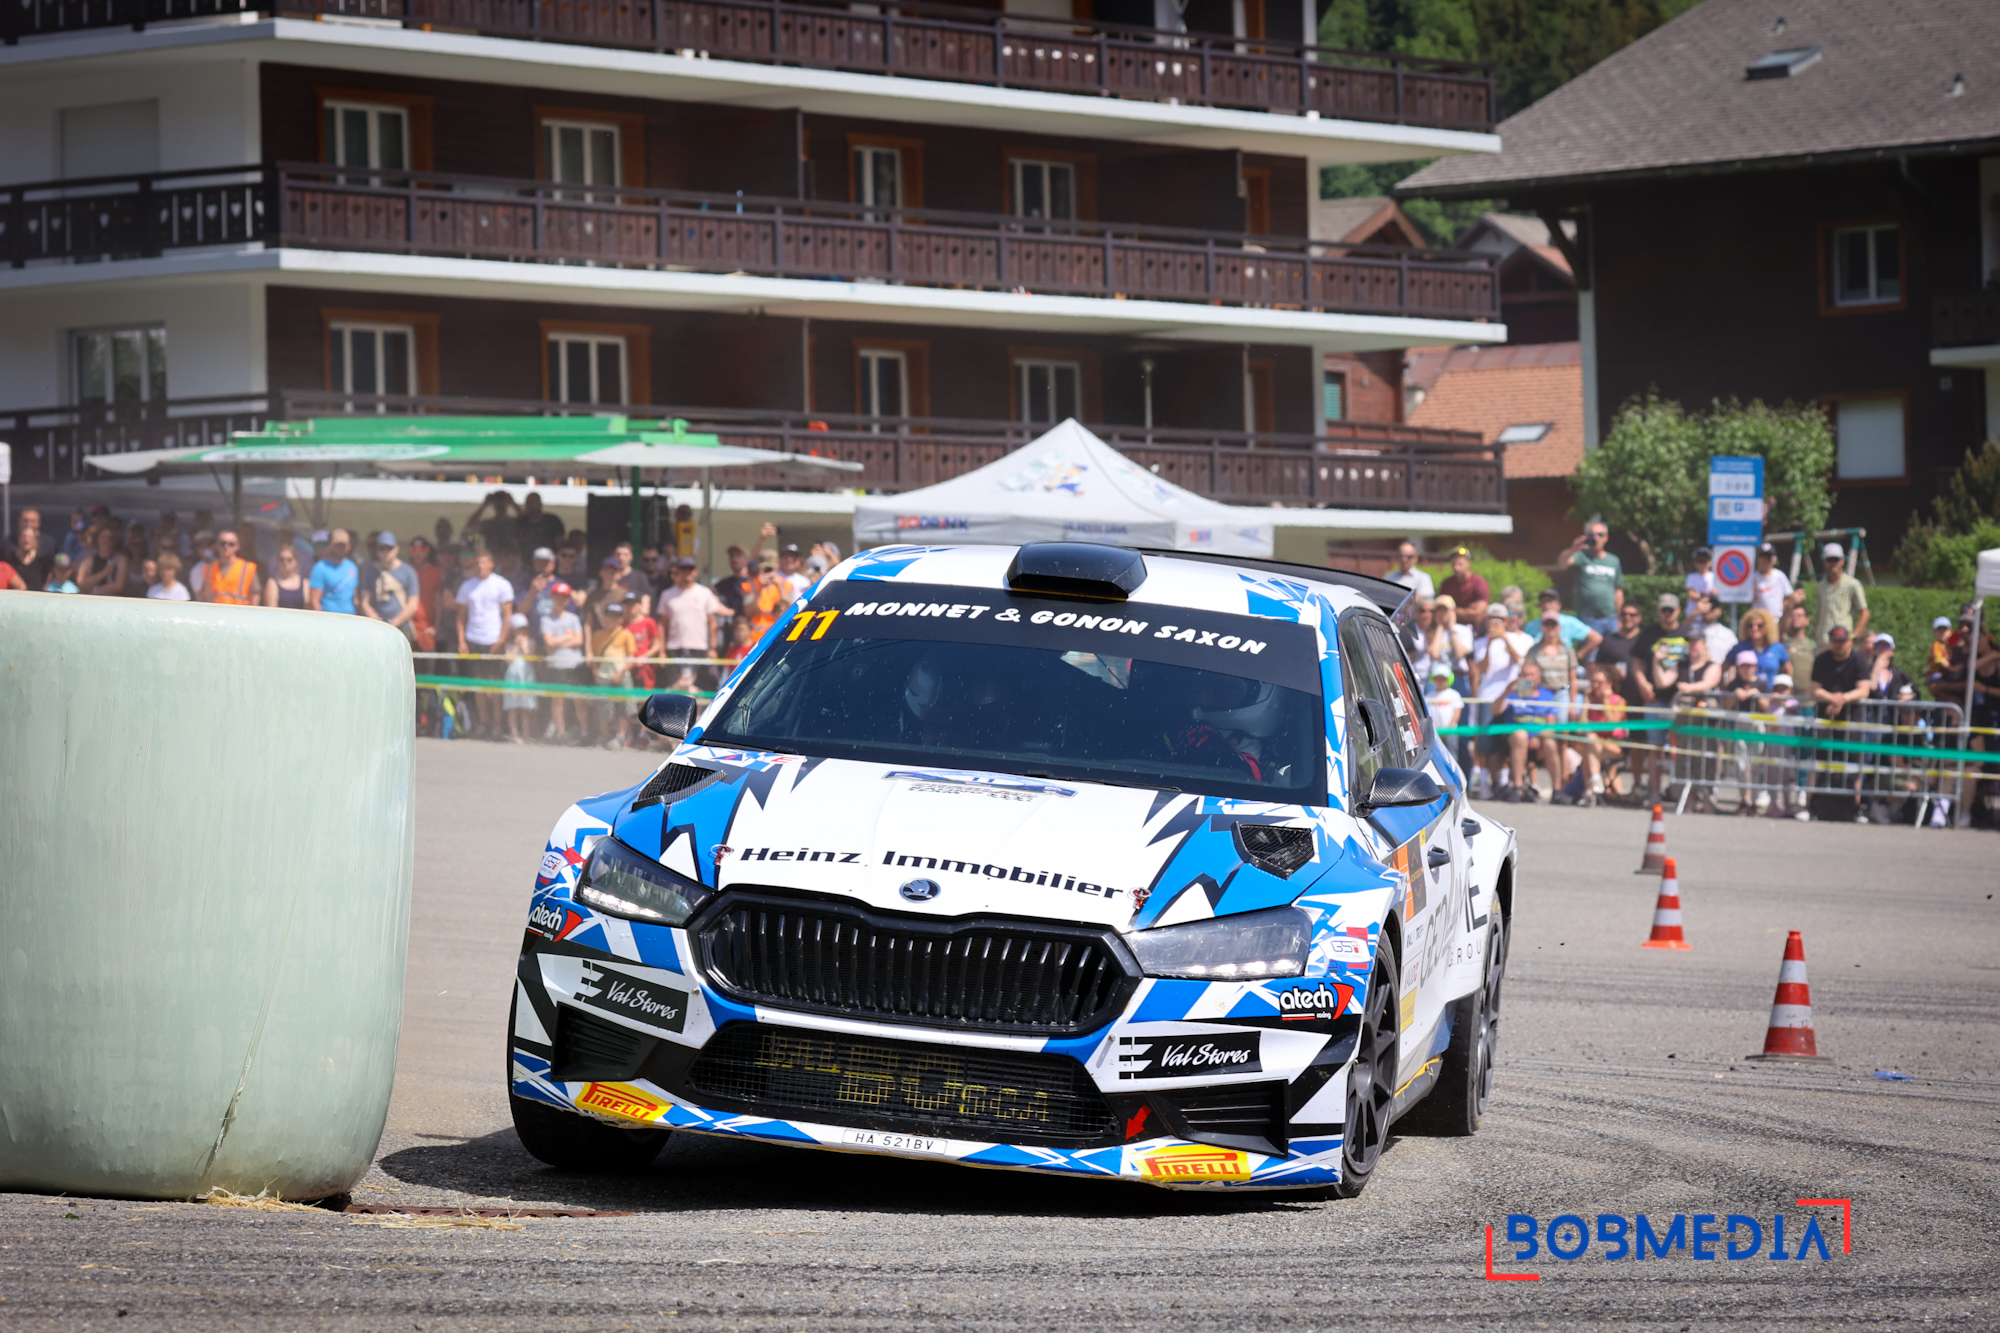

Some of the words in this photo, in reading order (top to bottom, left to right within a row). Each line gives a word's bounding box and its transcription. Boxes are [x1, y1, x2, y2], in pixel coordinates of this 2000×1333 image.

[785, 610, 840, 642] 11
[844, 602, 991, 619] MONNET
[994, 608, 1022, 623] &
[1030, 610, 1149, 636] GONON
[1153, 624, 1268, 655] SAXON
[739, 847, 863, 865] Heinz
[881, 850, 1124, 900] Immobilier
[532, 902, 563, 931] atech
[606, 980, 636, 1005] Val
[629, 990, 679, 1020] Stores
[1280, 983, 1334, 1010] atech
[1161, 1043, 1197, 1067] Val
[1192, 1043, 1251, 1066] Stores
[582, 1082, 659, 1120] PIRELLI
[855, 1133, 874, 1144] HA
[882, 1136, 934, 1150] 521BV
[1144, 1152, 1241, 1176] PIRELLI
